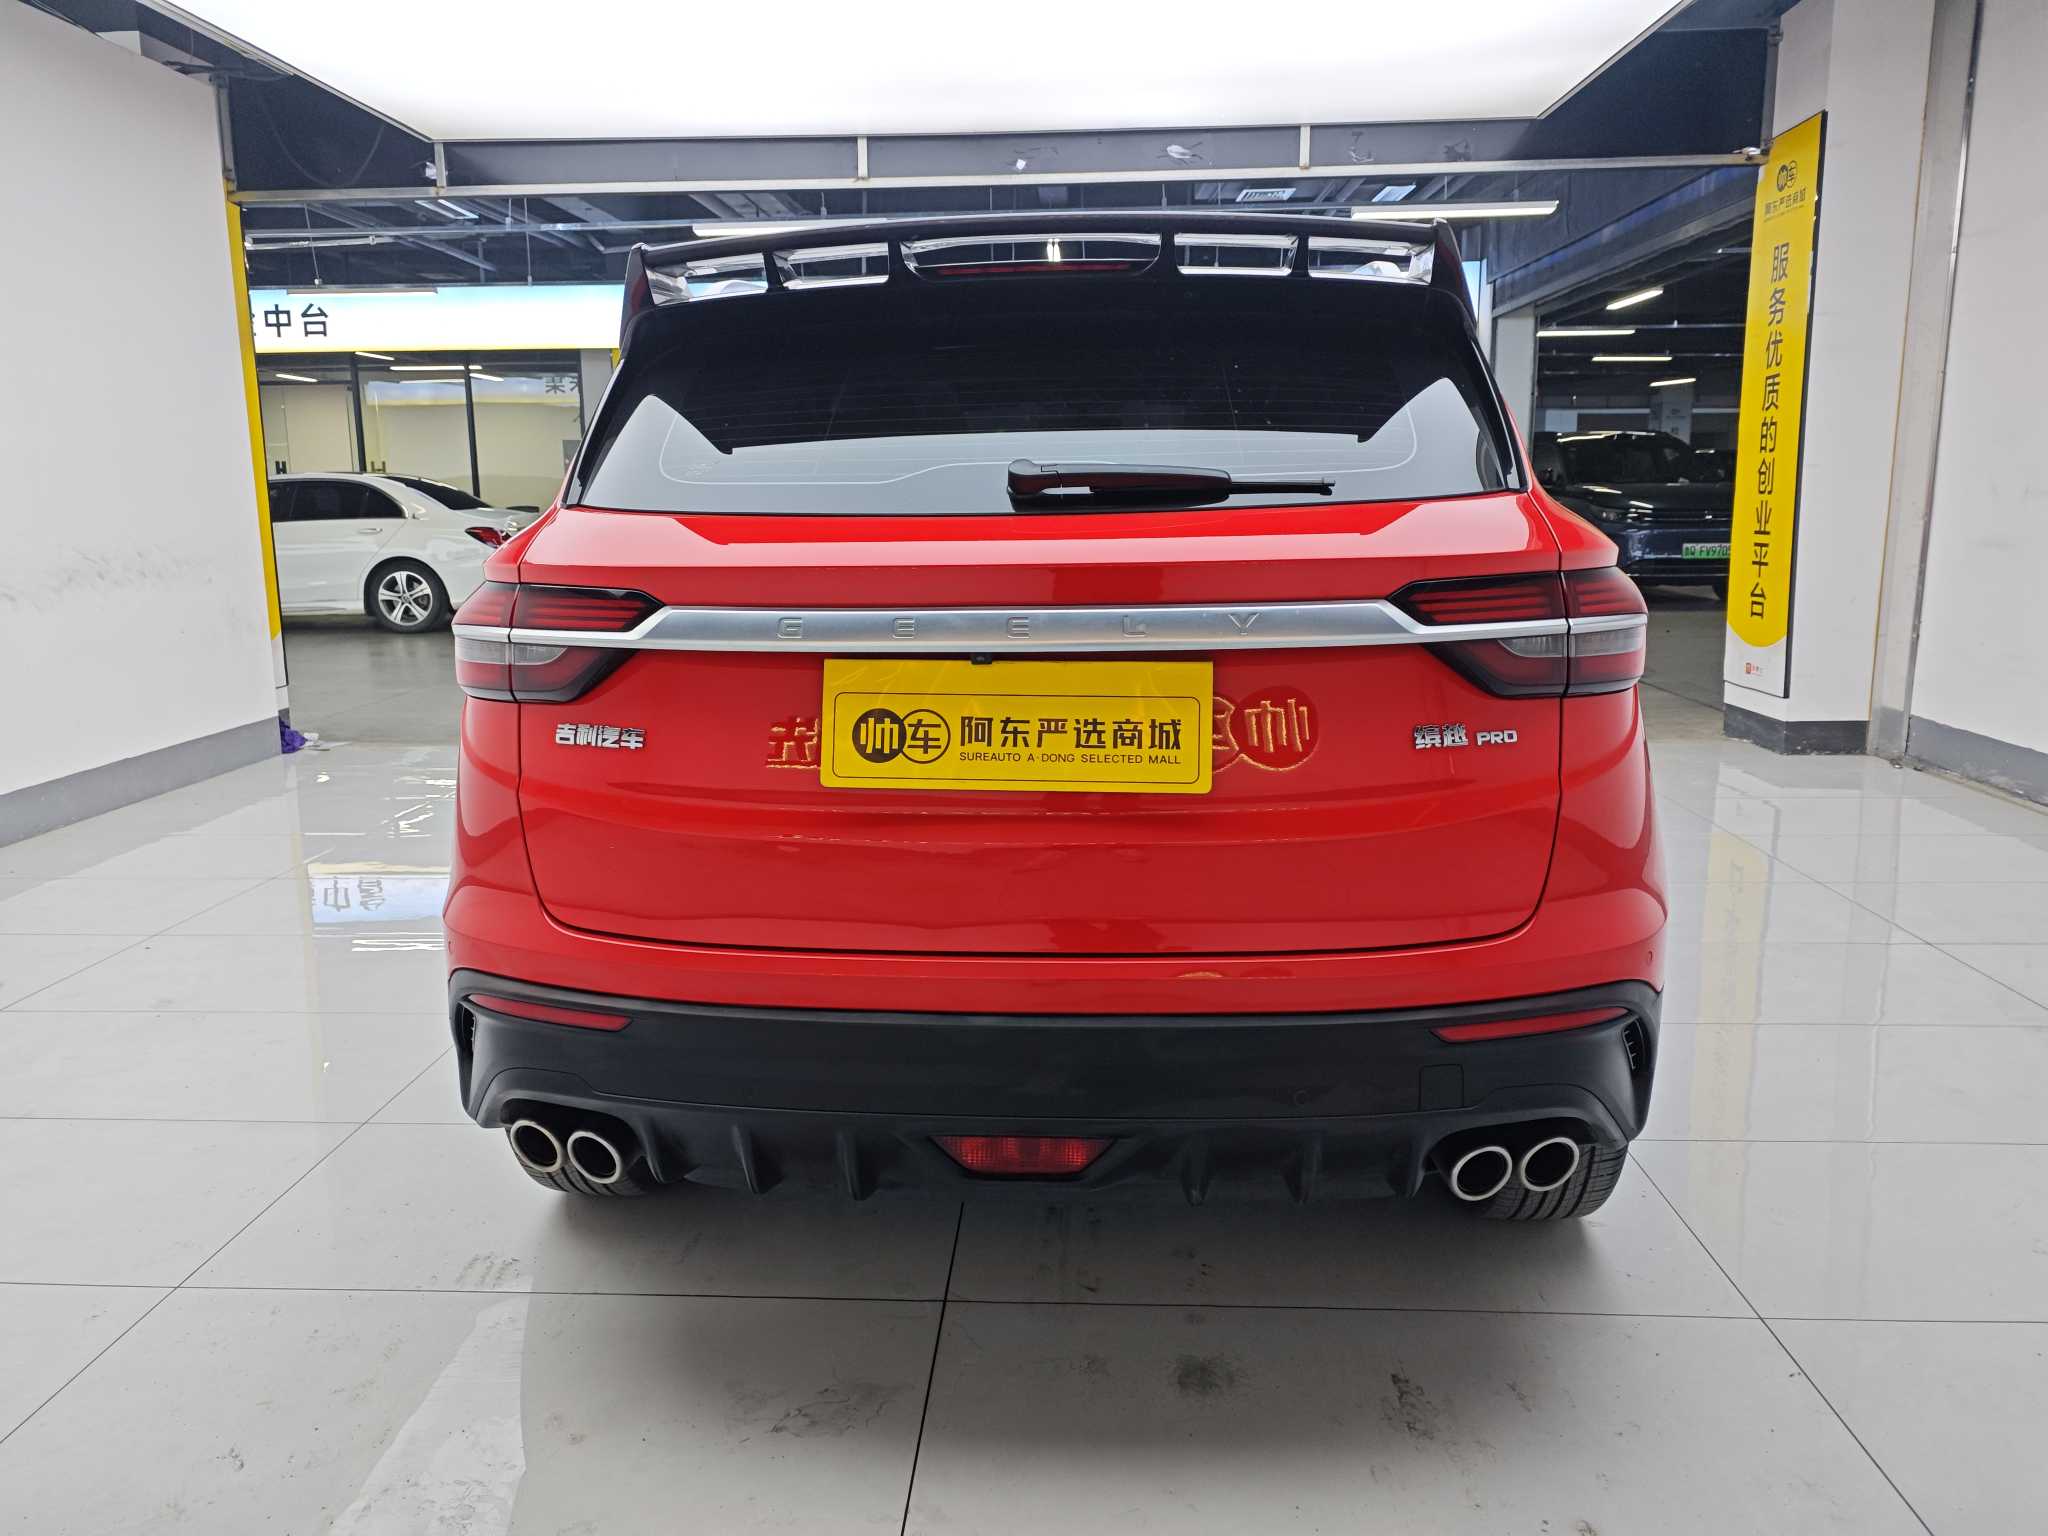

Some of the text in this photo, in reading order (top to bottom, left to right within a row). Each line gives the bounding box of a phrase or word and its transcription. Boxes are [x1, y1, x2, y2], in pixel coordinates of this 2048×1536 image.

[251, 303, 329, 337] 中台
[1750, 241, 1790, 619] 服务优质的创业平台
[777, 612, 1260, 639] GEELY
[555, 723, 646, 749] 吉利汽车
[960, 716, 1182, 750] 阿东严选商城
[1476, 730, 1518, 746] PRO
[959, 751, 1021, 762] SUREAUTO
[1081, 754, 1143, 764] SELECTED
[1148, 754, 1181, 764] MALL
